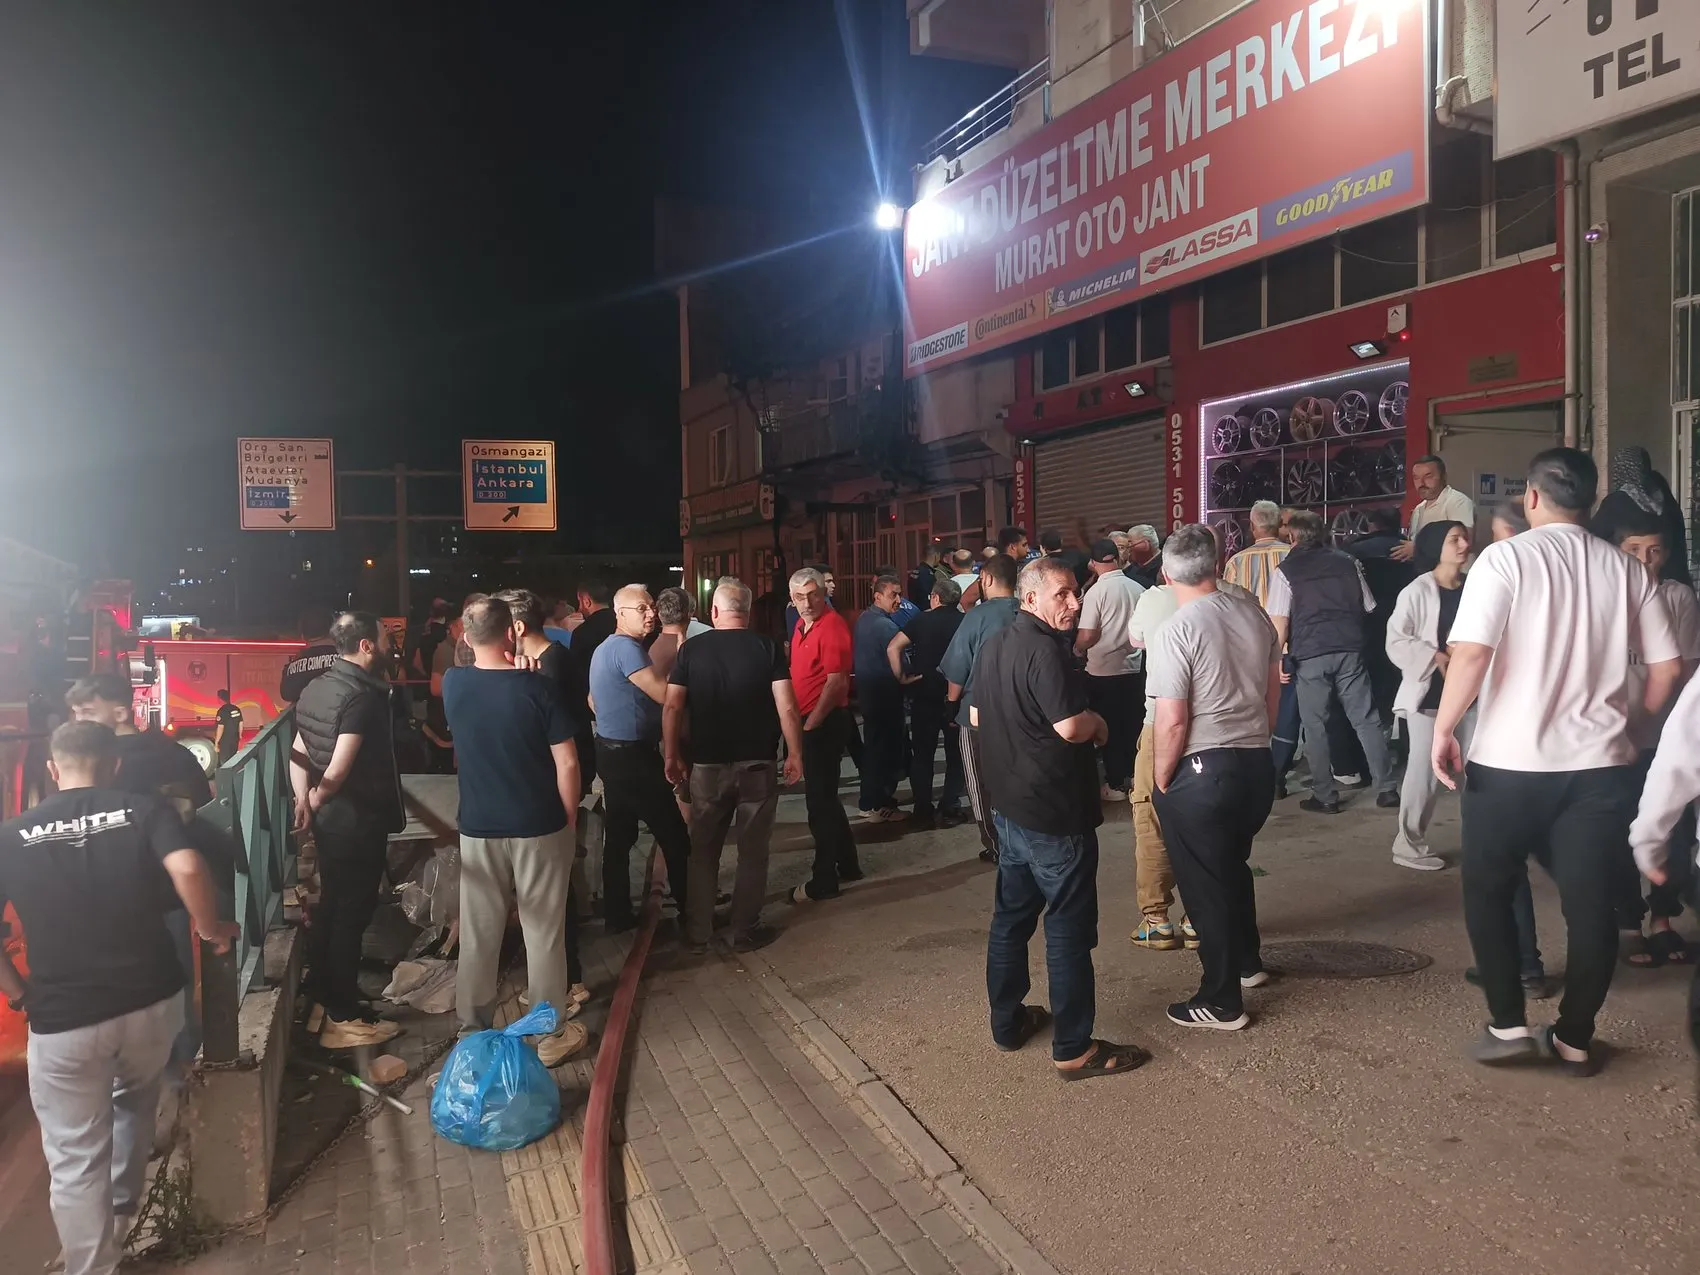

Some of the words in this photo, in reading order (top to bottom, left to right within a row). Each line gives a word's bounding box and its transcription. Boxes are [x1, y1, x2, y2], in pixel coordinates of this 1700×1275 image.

[1583, 32, 1681, 99] TEL
[981, 93, 1153, 244] DÜZELTME
[995, 220, 1070, 293] MURAT
[1075, 195, 1126, 258] OTO
[1133, 153, 1210, 235] JANT
[1168, 218, 1253, 267] LASSA
[1069, 267, 1136, 302] MICHELIN
[975, 302, 1028, 340] Continental
[910, 329, 966, 364] BRIDGESTONE
[471, 445, 547, 459] Osmangazi
[475, 460, 543, 474] İstanbul
[245, 465, 305, 475] Ataevler
[245, 476, 308, 486] Mudanya
[477, 477, 534, 488] Ankara
